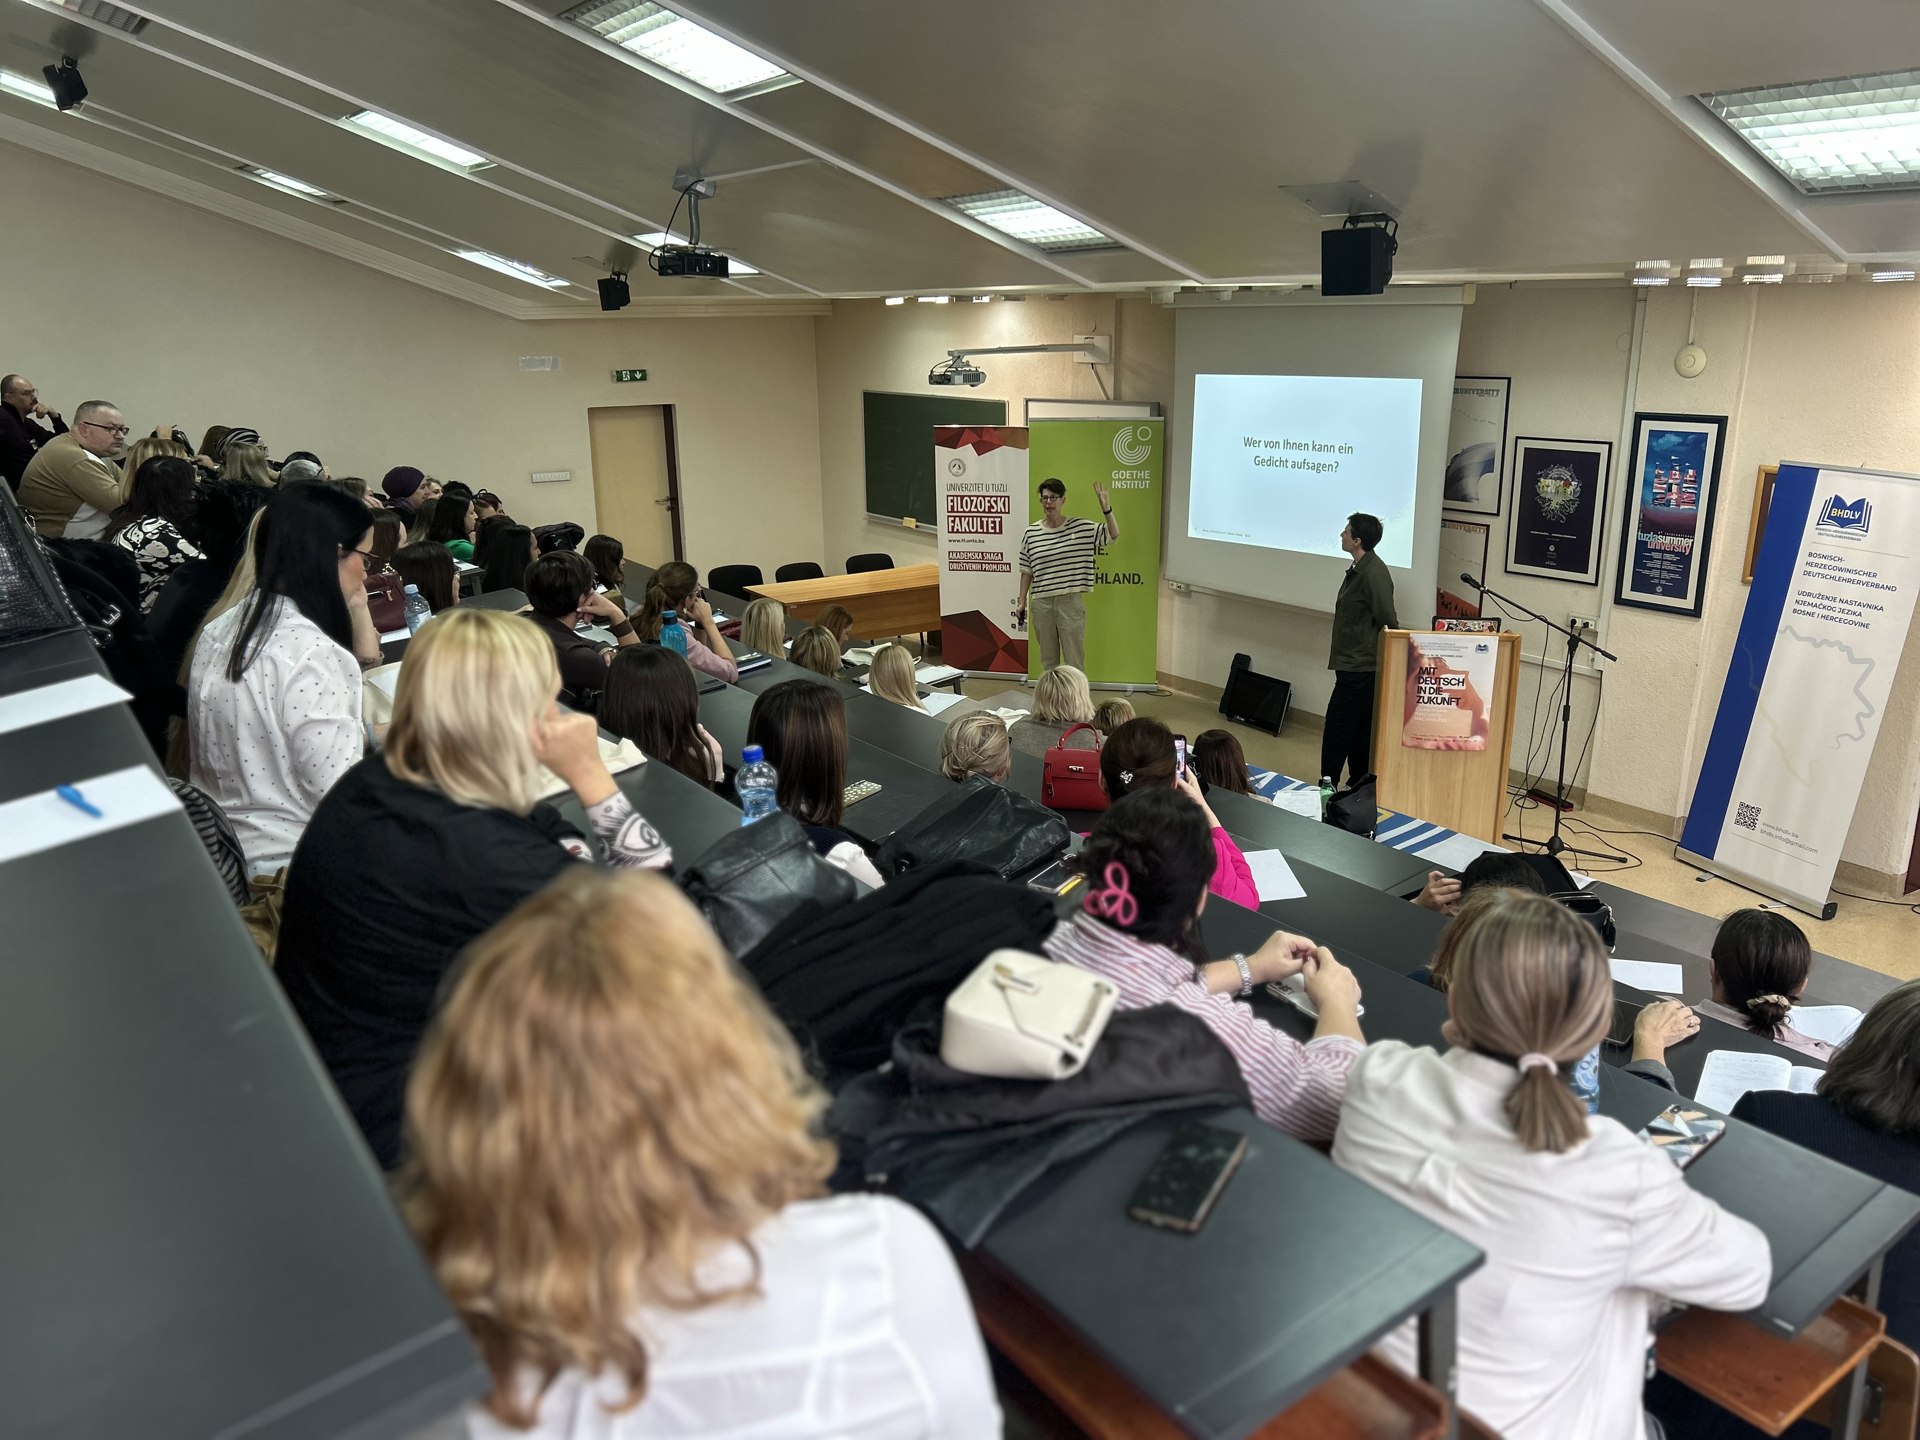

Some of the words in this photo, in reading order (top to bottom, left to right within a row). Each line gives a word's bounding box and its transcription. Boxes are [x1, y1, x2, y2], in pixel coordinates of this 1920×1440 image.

[1243, 436, 1262, 448] Wer
[1263, 439, 1281, 450] von
[1282, 438, 1309, 451] Ihnen
[1311, 440, 1336, 453] kann
[1337, 442, 1354, 455] ein
[1253, 455, 1289, 469] Gedicht
[1290, 458, 1339, 473] aufsagen?
[1111, 470, 1151, 479] GOETHE
[946, 482, 984, 492] UNIVERZITET
[985, 483, 991, 492] U
[991, 483, 1008, 492] TUZLI
[1111, 480, 1151, 489] INSTITUT
[947, 496, 1009, 513] FILOZOFSKI
[1831, 508, 1862, 520] BHDLV
[948, 517, 1001, 533] FAKULTET
[1647, 540, 1691, 556] university
[949, 551, 983, 560] AKADEMSKA
[983, 552, 1002, 561] SNAGA
[1808, 551, 1845, 563] BOSNISCH-
[949, 561, 982, 571] DRUŠTVENIH
[982, 563, 1010, 572] PROMJENA
[1805, 561, 1878, 579] HERZEGOWINISCHER
[1095, 572, 1144, 585] HLAND.
[1802, 570, 1898, 592] DEUTSCHLEHRERVERBAND
[1797, 590, 1838, 602] UDRUŽENJE
[1838, 597, 1885, 612] NASTAVNIKA
[1794, 599, 1837, 613] NJEMAČKOG
[1837, 607, 1863, 617] JEZIKA
[1792, 608, 1815, 618] BOSNE
[1820, 614, 1871, 630] HERCEGOVINE
[1417, 666, 1438, 676] MIT
[1417, 676, 1465, 687] DEUTSCH
[1416, 686, 1427, 695] IN
[1428, 687, 1443, 696] DIE
[1416, 695, 1461, 706] ZUKUNFT
